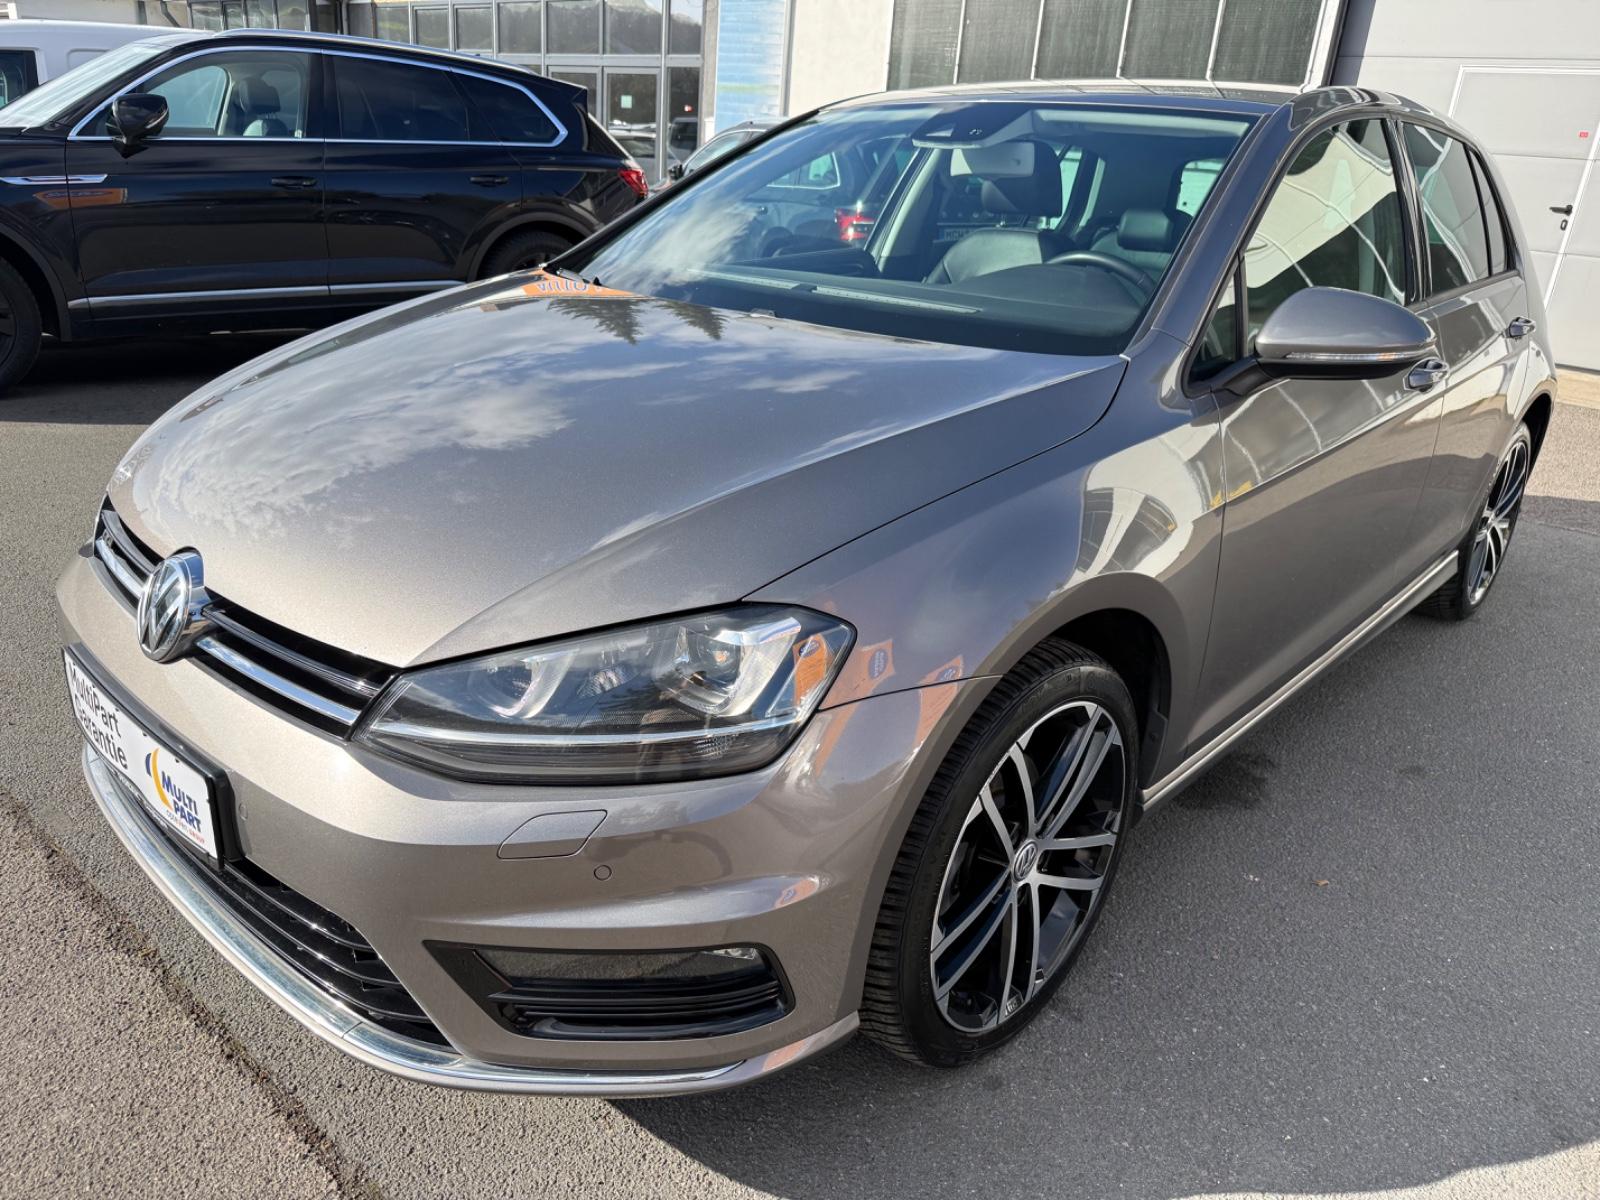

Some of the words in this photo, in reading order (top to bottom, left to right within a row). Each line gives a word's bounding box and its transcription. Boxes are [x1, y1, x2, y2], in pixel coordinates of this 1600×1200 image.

[68, 661, 121, 738] MultiPart
[75, 693, 128, 769] Garantie
[161, 770, 198, 816] MULTI
[173, 798, 202, 833] PART
